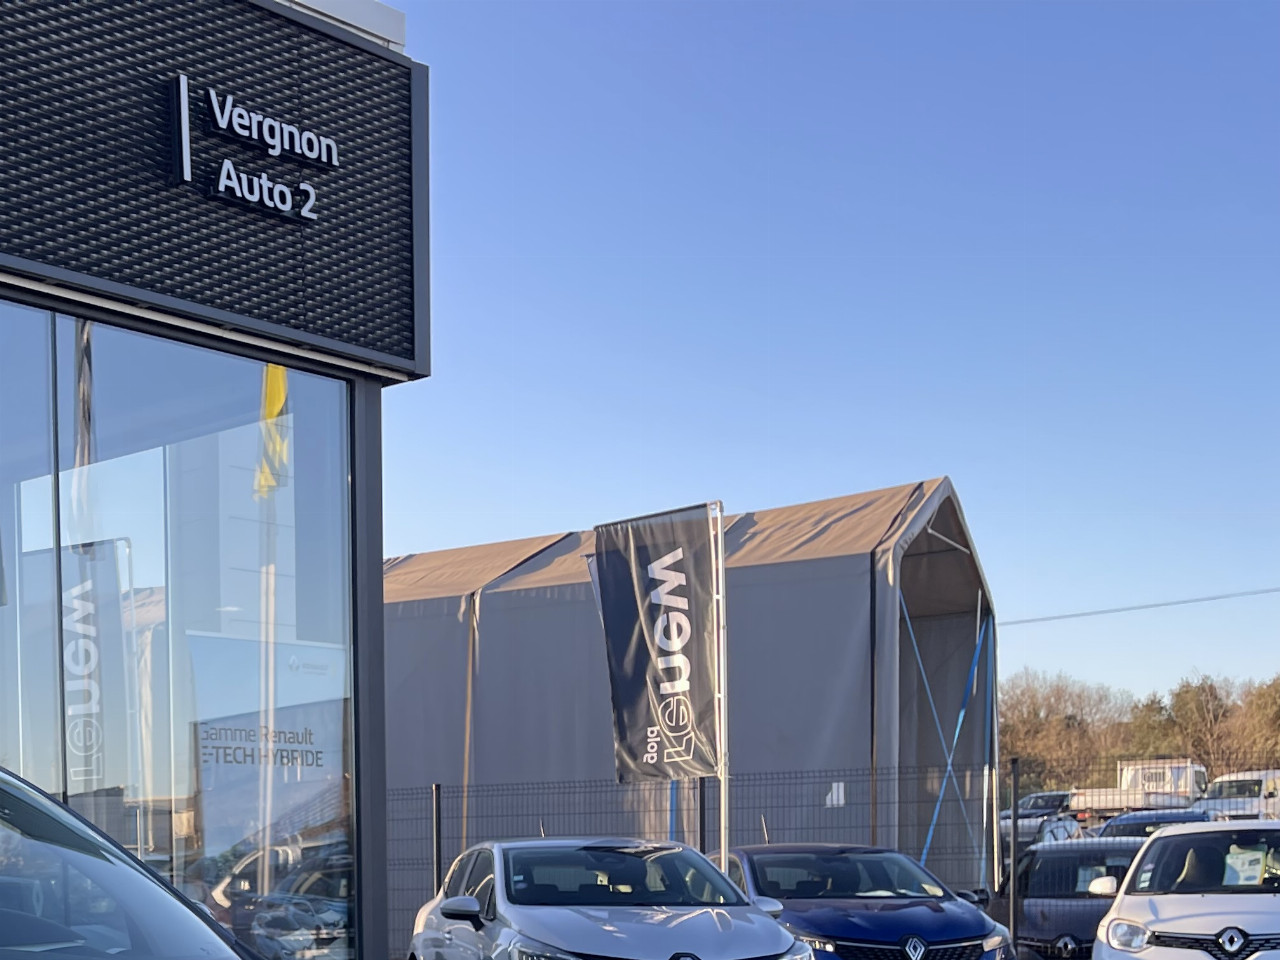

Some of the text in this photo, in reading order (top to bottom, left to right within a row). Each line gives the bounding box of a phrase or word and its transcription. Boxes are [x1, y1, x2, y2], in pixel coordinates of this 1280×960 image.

[209, 87, 340, 167] Vergnon
[219, 158, 318, 220] Auto 2
[259, 725, 315, 746] Renault
